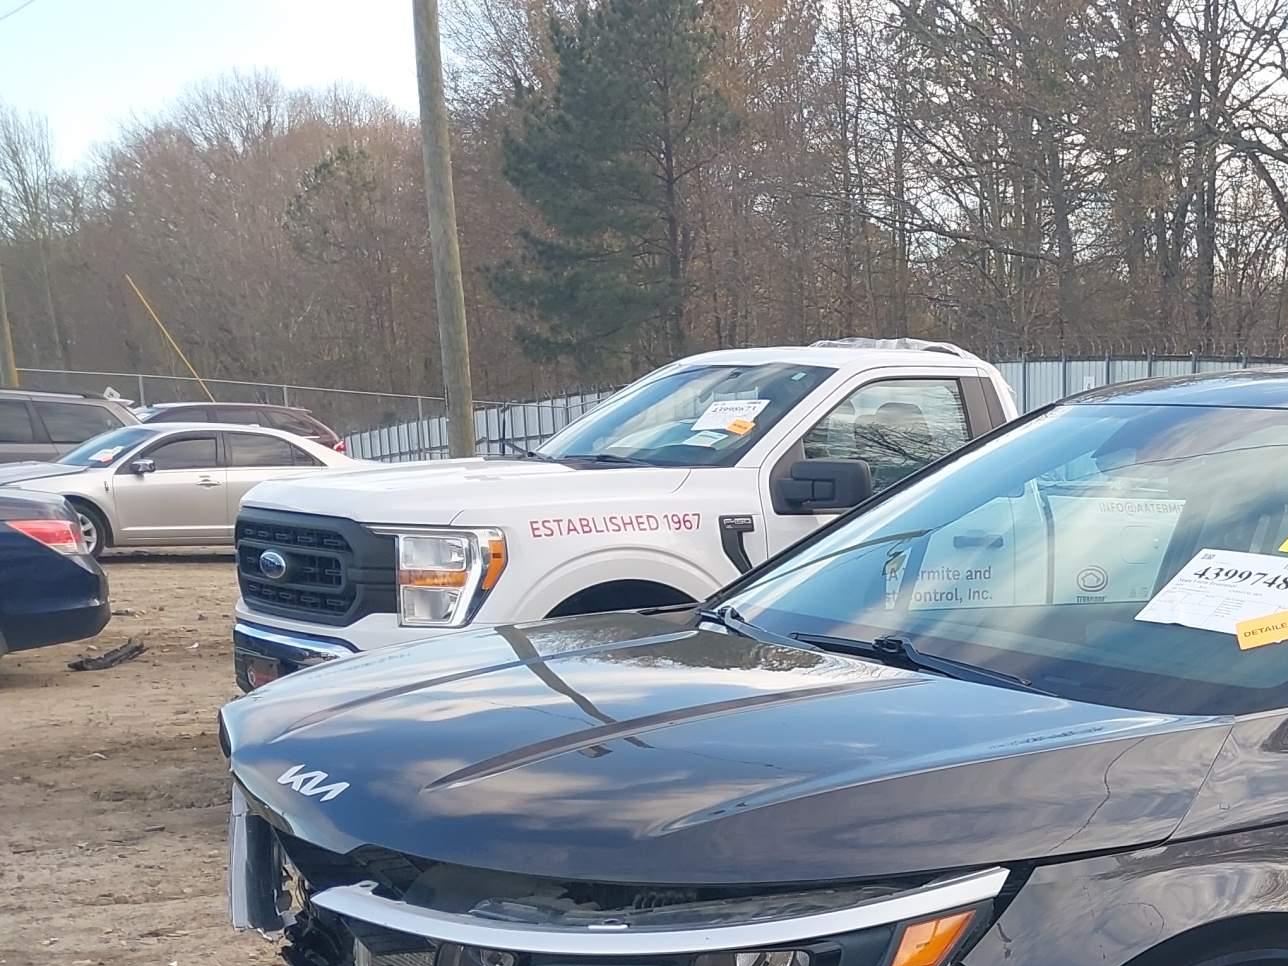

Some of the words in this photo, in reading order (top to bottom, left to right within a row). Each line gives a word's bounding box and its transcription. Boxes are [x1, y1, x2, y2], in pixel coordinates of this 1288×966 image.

[529, 514, 660, 538] ESTABLISHED
[663, 512, 702, 531] 1967
[920, 566, 961, 581] rmite
[965, 565, 992, 580] and
[914, 587, 963, 604] ontrol,
[968, 587, 993, 601] Inc.
